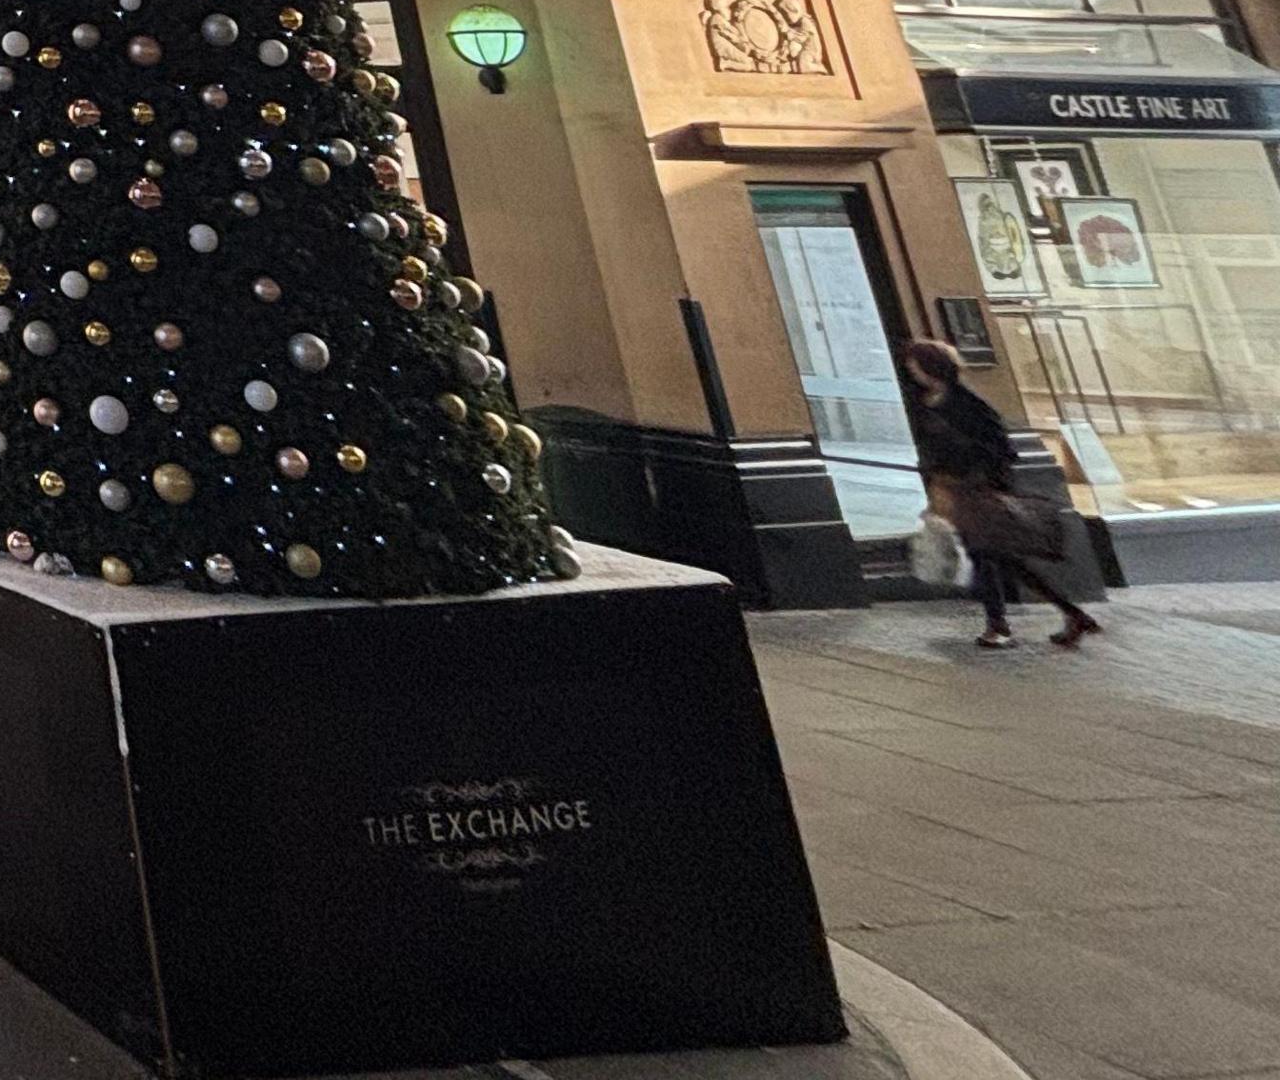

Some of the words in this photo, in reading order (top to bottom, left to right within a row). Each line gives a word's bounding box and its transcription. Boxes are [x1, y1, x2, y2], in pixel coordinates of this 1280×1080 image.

[1049, 94, 1134, 118] CASTLE
[1136, 96, 1188, 120] FINE
[1192, 98, 1232, 120] ART
[363, 814, 419, 845] THE
[427, 800, 591, 842] EXCHANGE
